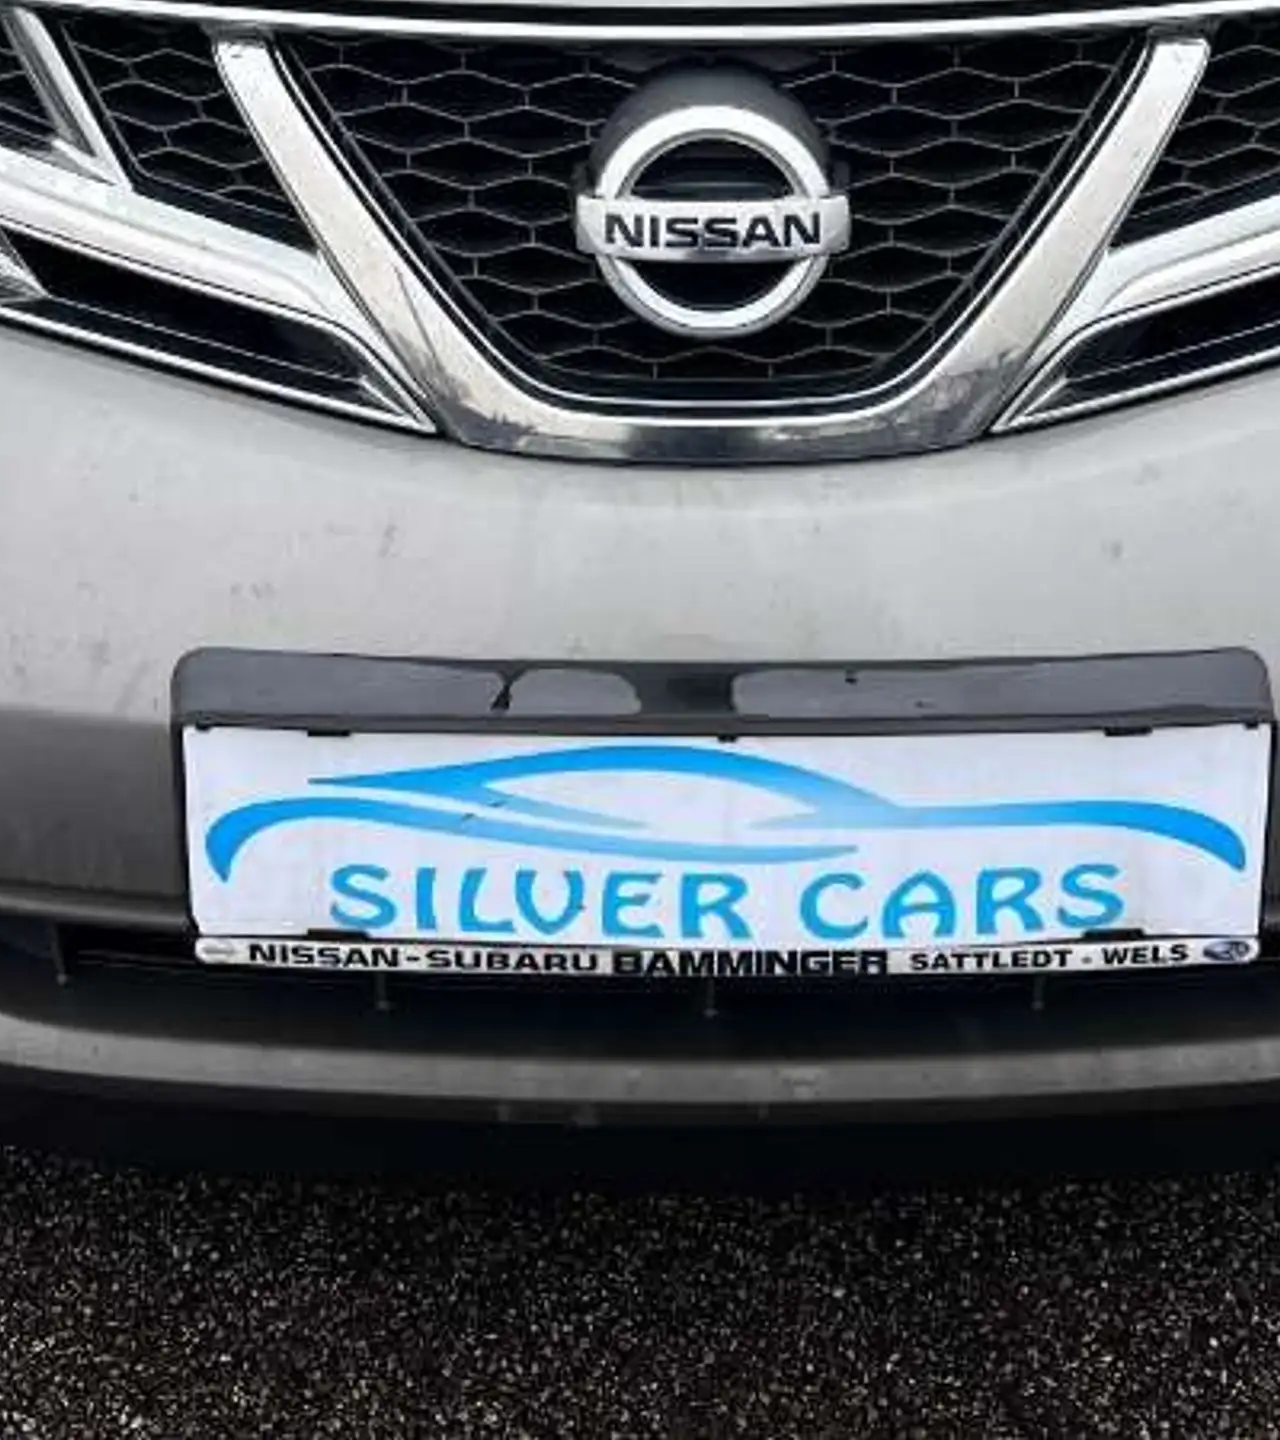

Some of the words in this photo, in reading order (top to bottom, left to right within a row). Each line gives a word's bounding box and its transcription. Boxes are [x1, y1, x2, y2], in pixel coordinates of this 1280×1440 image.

[605, 213, 821, 247] NISSAN
[330, 863, 752, 940] SILVER
[800, 863, 1124, 940] CARS
[248, 943, 600, 974] NISSAN-SUBARU
[611, 949, 890, 976] BAMMINGER
[909, 948, 1073, 972] SATTLEDT
[1101, 942, 1190, 965] WELS
